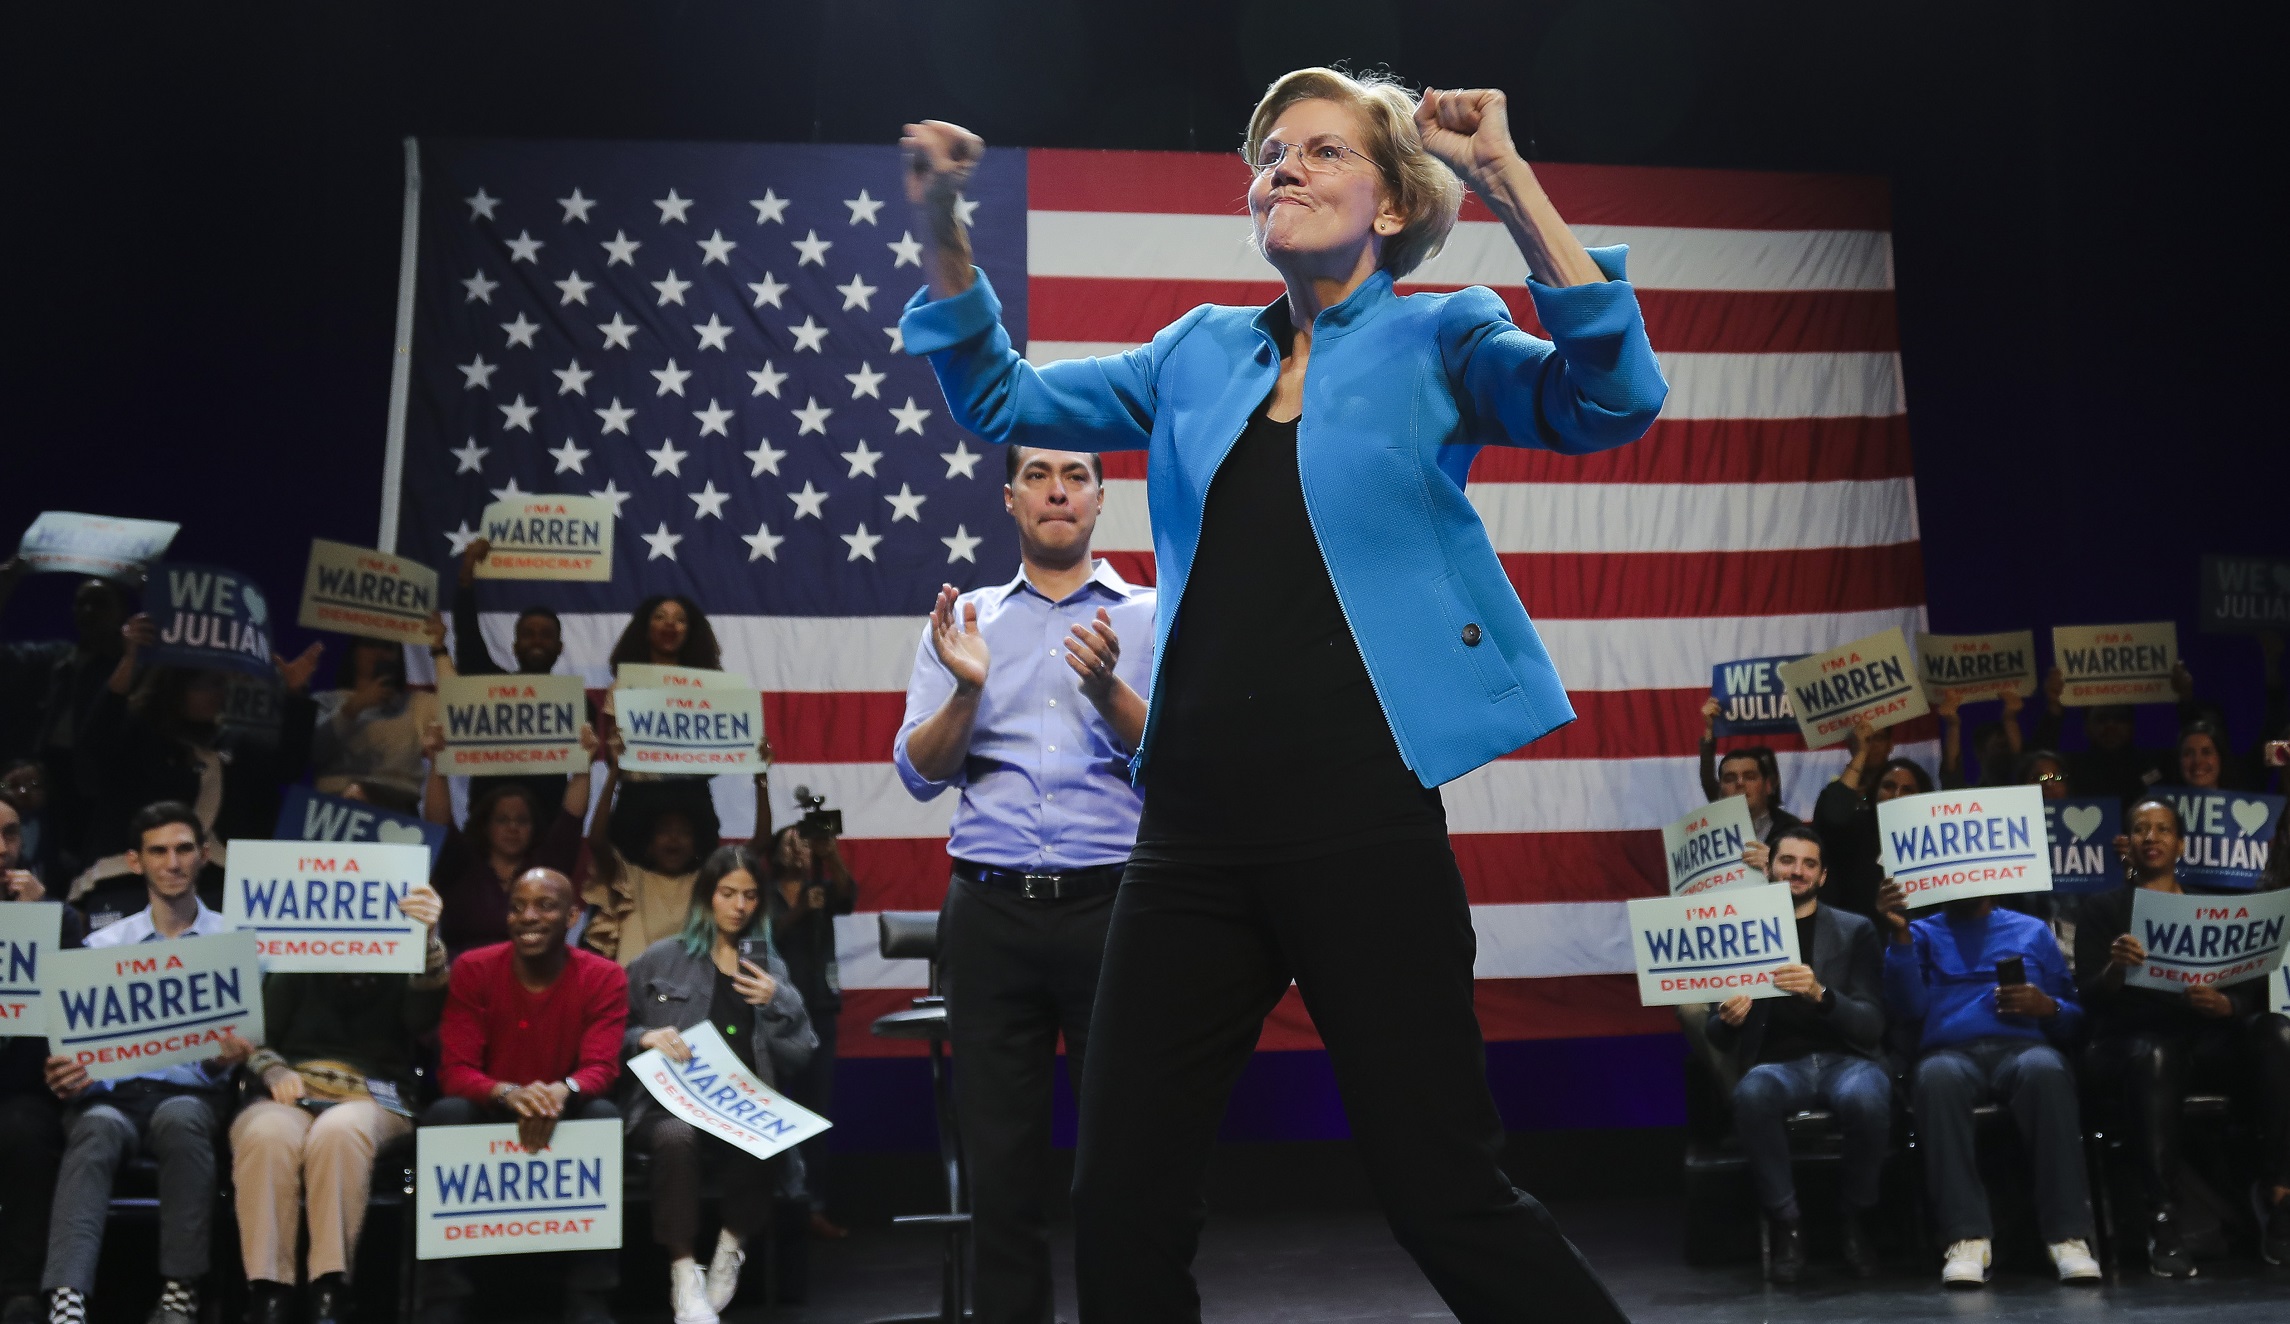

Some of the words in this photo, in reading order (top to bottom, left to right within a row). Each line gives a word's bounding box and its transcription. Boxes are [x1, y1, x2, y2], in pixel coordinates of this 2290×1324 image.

[555, 505, 566, 514] A
[489, 518, 599, 545] WARREN
[387, 563, 399, 574] A
[491, 556, 593, 568] DEMOCRAT
[319, 564, 430, 610] WARREN
[2217, 561, 2267, 593] WE
[168, 570, 238, 616] WE
[318, 606, 421, 631] DEMOCRAT
[1980, 642, 1991, 653] A
[2122, 633, 2134, 643] A
[1850, 652, 1862, 665] A
[1925, 650, 2024, 678] WARREN
[2063, 645, 2168, 675] WARREN
[523, 685, 536, 698] A
[692, 678, 703, 688] A
[1724, 661, 1773, 695] WE
[1795, 655, 1906, 713] WARREN
[2072, 683, 2162, 696] DEMOCRAT
[698, 699, 711, 709] A
[447, 702, 573, 736] WARREN
[627, 709, 749, 740] WARREN
[454, 747, 569, 764] DEMOCRAT
[636, 750, 746, 763] DEMOCRAT
[303, 799, 375, 841] WE
[1700, 816, 1709, 828] A
[1931, 803, 1963, 818] I'M
[1968, 802, 1983, 814] A
[1672, 823, 1744, 879] WARREN
[1891, 816, 2032, 865] WARREN
[2182, 829, 2269, 871] ULIÁN
[298, 858, 335, 872] I'M
[343, 859, 360, 872] A
[1904, 865, 2028, 894] DEMOCRAT
[241, 879, 408, 921] WARREN
[1685, 906, 1718, 922] I'M
[1723, 904, 1738, 917] A
[2196, 907, 2229, 920] I'M
[2235, 906, 2249, 919] A
[1645, 916, 1785, 964] WARREN
[2145, 914, 2286, 958] WARREN
[115, 958, 157, 976] I'M
[165, 955, 183, 969] A
[2149, 957, 2269, 984] DEMOCRAT
[60, 967, 241, 1030] WARREN
[653, 1070, 760, 1144] DEMOCRAT
[757, 1097, 772, 1106] A
[434, 1158, 602, 1205] WARREN
[444, 1218, 595, 1241] DEMOCRAT
